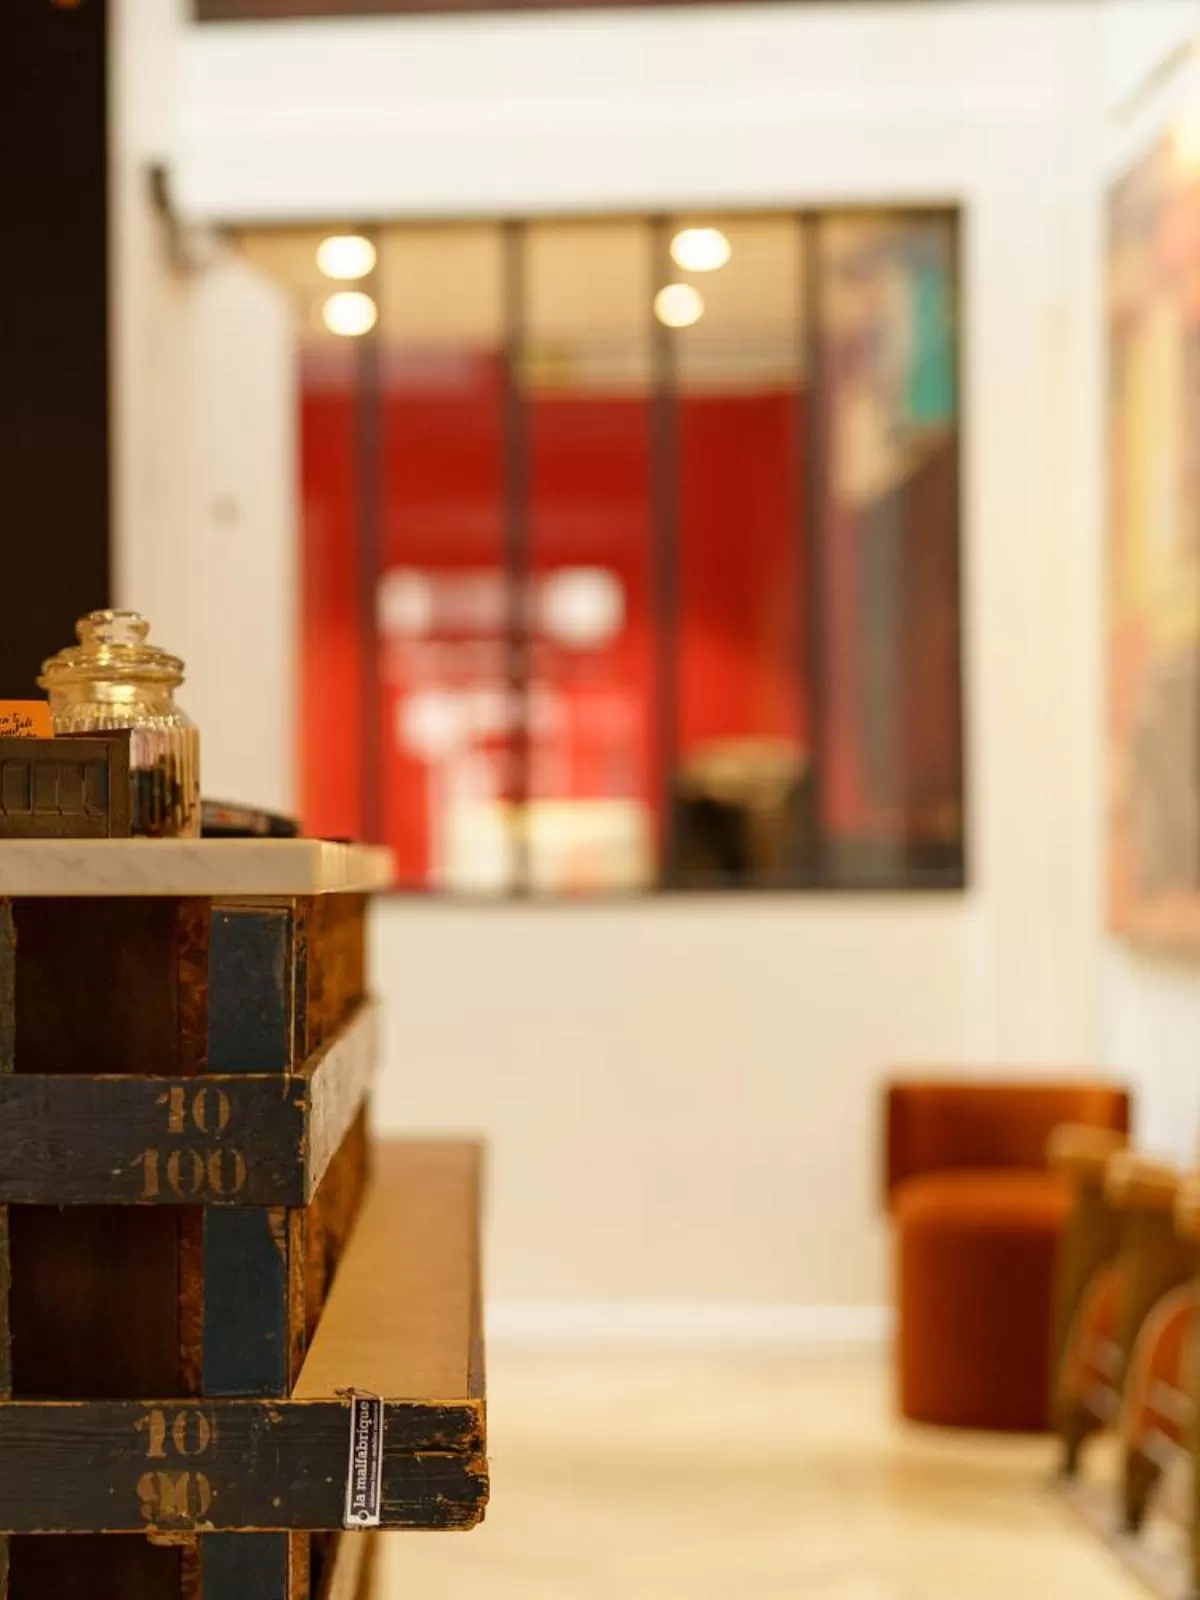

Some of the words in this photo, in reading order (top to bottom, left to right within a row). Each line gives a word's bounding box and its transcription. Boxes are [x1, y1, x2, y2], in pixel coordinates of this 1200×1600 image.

[155, 1087, 231, 1133] 10
[130, 1148, 246, 1199] 100
[133, 1409, 211, 1457] 10
[355, 1401, 371, 1490] malfabrique
[136, 1471, 210, 1519] 90
[353, 1493, 366, 1508] la
